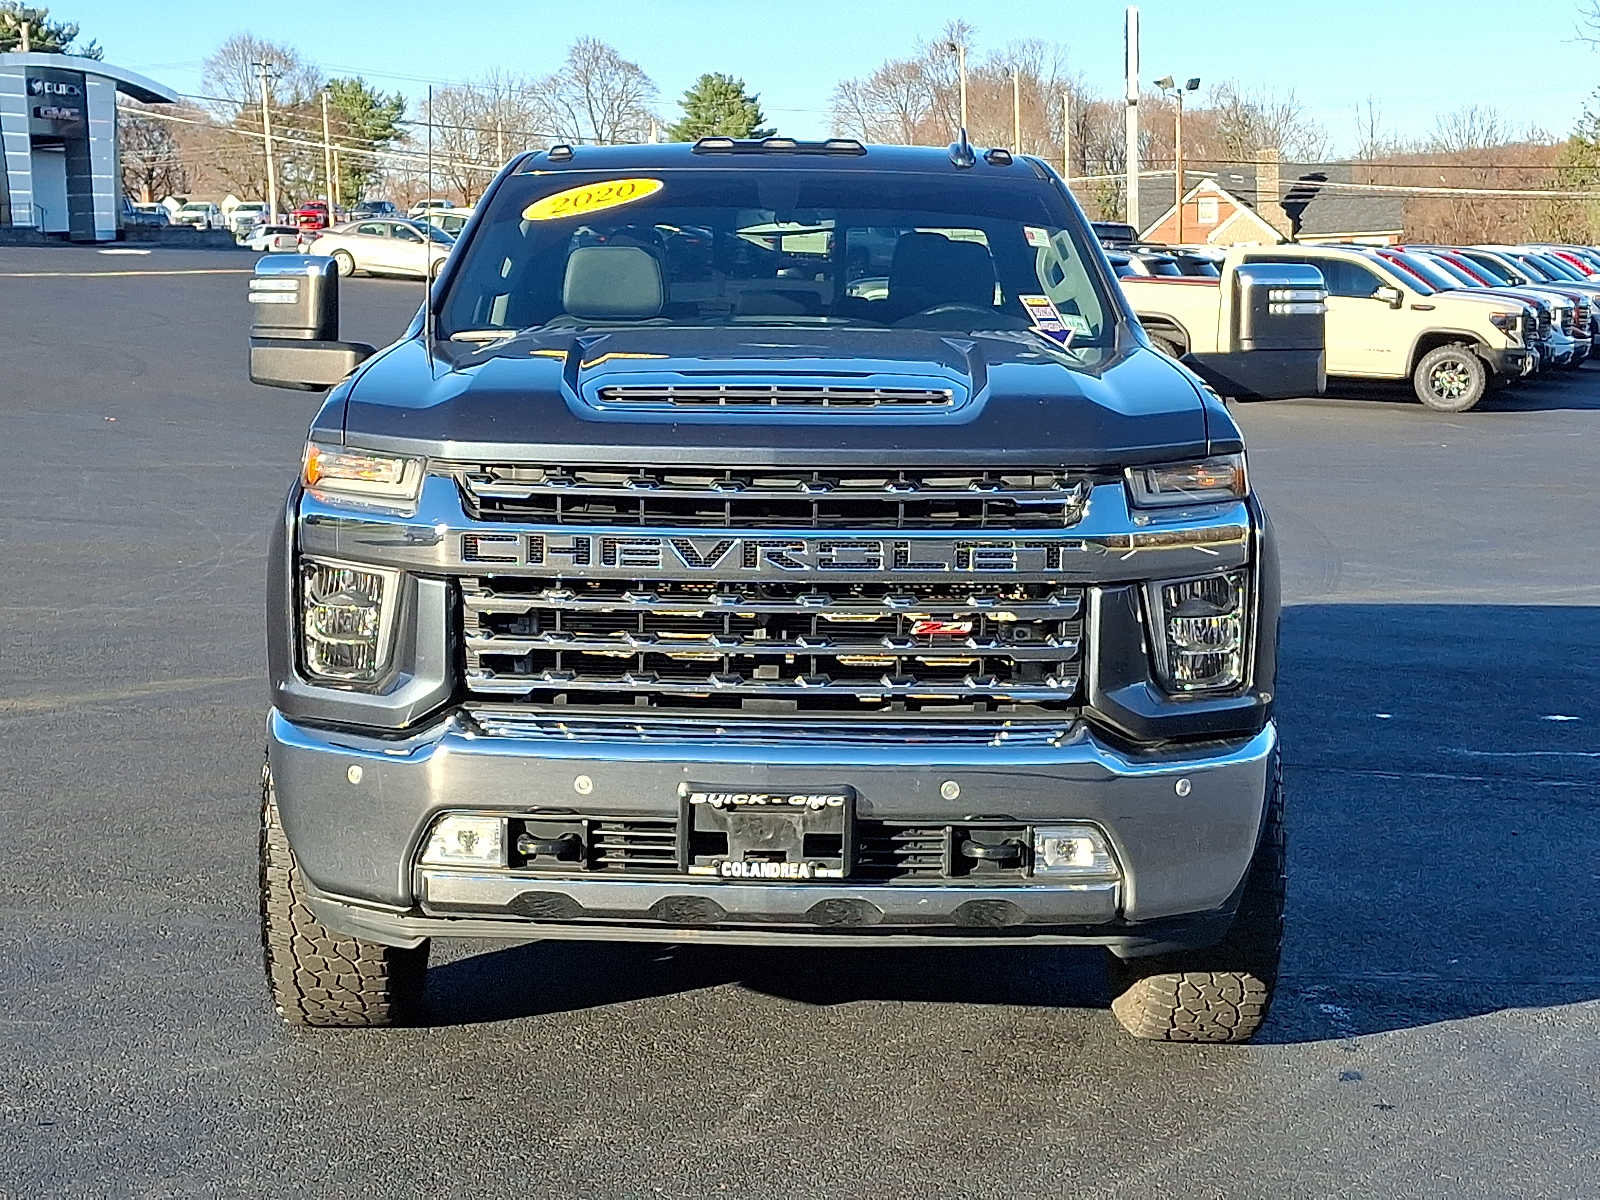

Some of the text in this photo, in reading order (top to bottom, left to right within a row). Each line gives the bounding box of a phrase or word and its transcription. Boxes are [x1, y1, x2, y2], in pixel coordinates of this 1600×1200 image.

[551, 183, 636, 214] 2020
[461, 533, 1087, 571] CHEVROLET
[689, 793, 768, 806] BUICK
[721, 861, 810, 879] COLANDREA
